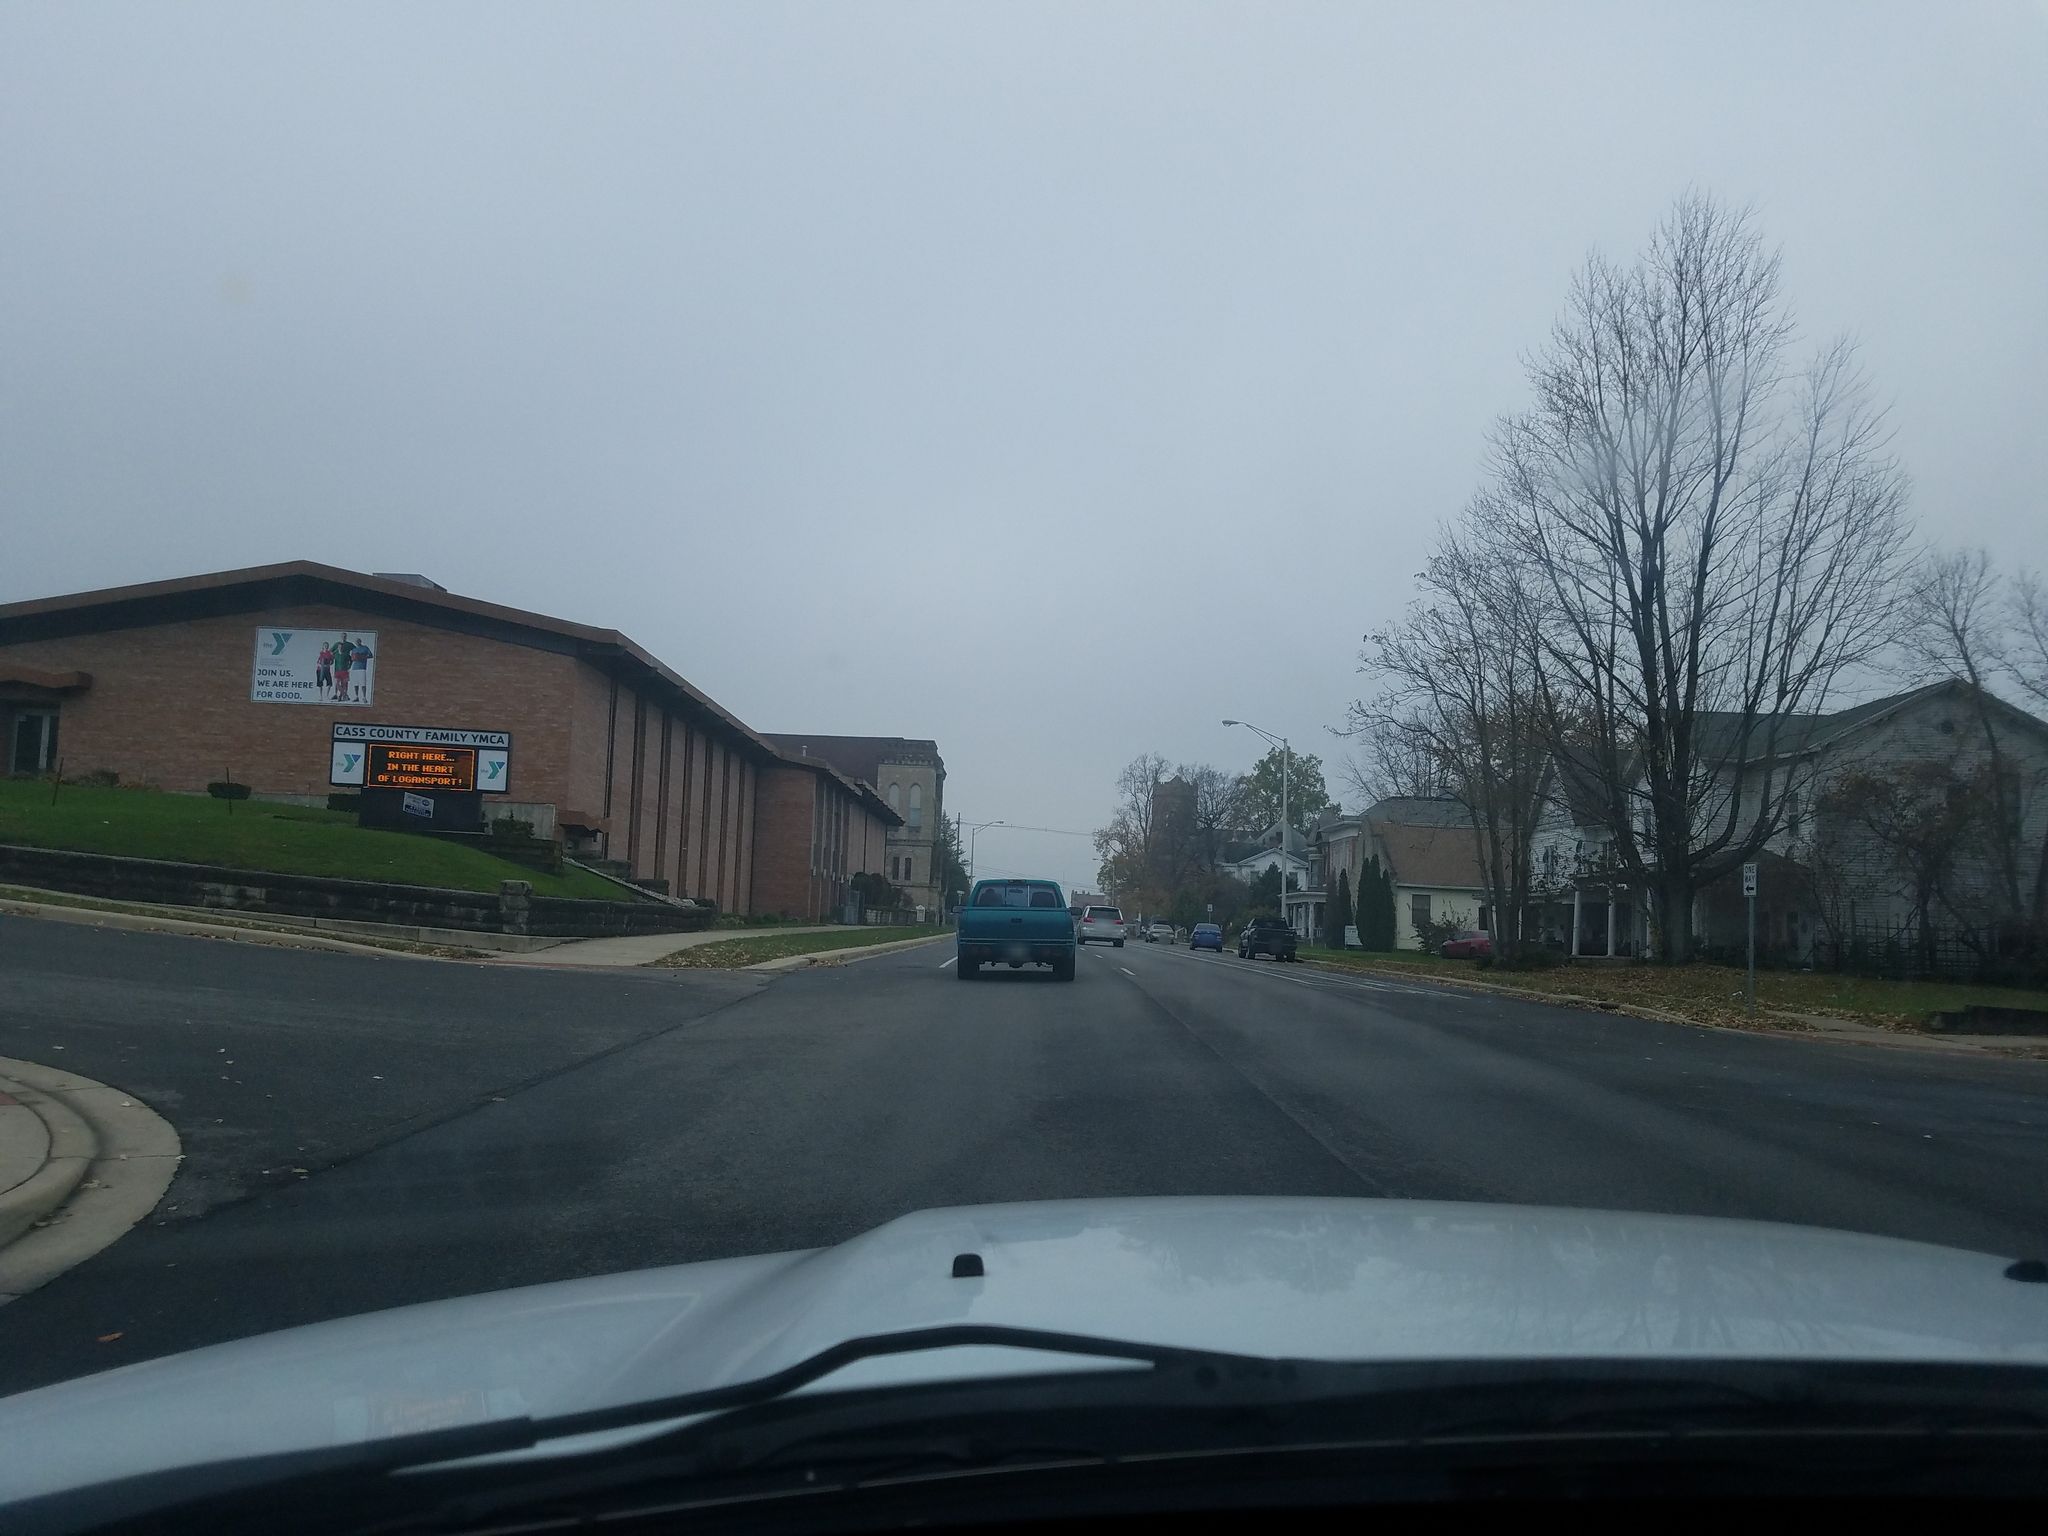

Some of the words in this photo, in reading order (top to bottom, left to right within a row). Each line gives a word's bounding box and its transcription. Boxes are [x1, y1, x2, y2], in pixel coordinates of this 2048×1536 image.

[257, 669, 277, 677] JOIN
[279, 669, 294, 678] US.
[257, 680, 271, 688] WE
[291, 681, 314, 689] HERE
[256, 690, 273, 698] FOR
[275, 691, 303, 700] GOOD.
[335, 726, 366, 737] CASS
[369, 728, 420, 740] COUNTY
[425, 731, 468, 742] FAMILY
[471, 734, 505, 745] YMCA
[388, 751, 419, 761] RIGHT
[386, 763, 399, 772] IN
[402, 764, 420, 773] THE
[422, 765, 454, 775] HEART
[377, 774, 390, 783] OF
[392, 775, 462, 786] LOGANSPORT!
[1745, 865, 1755, 874] ONE
[1745, 875, 1755, 883] WAY
